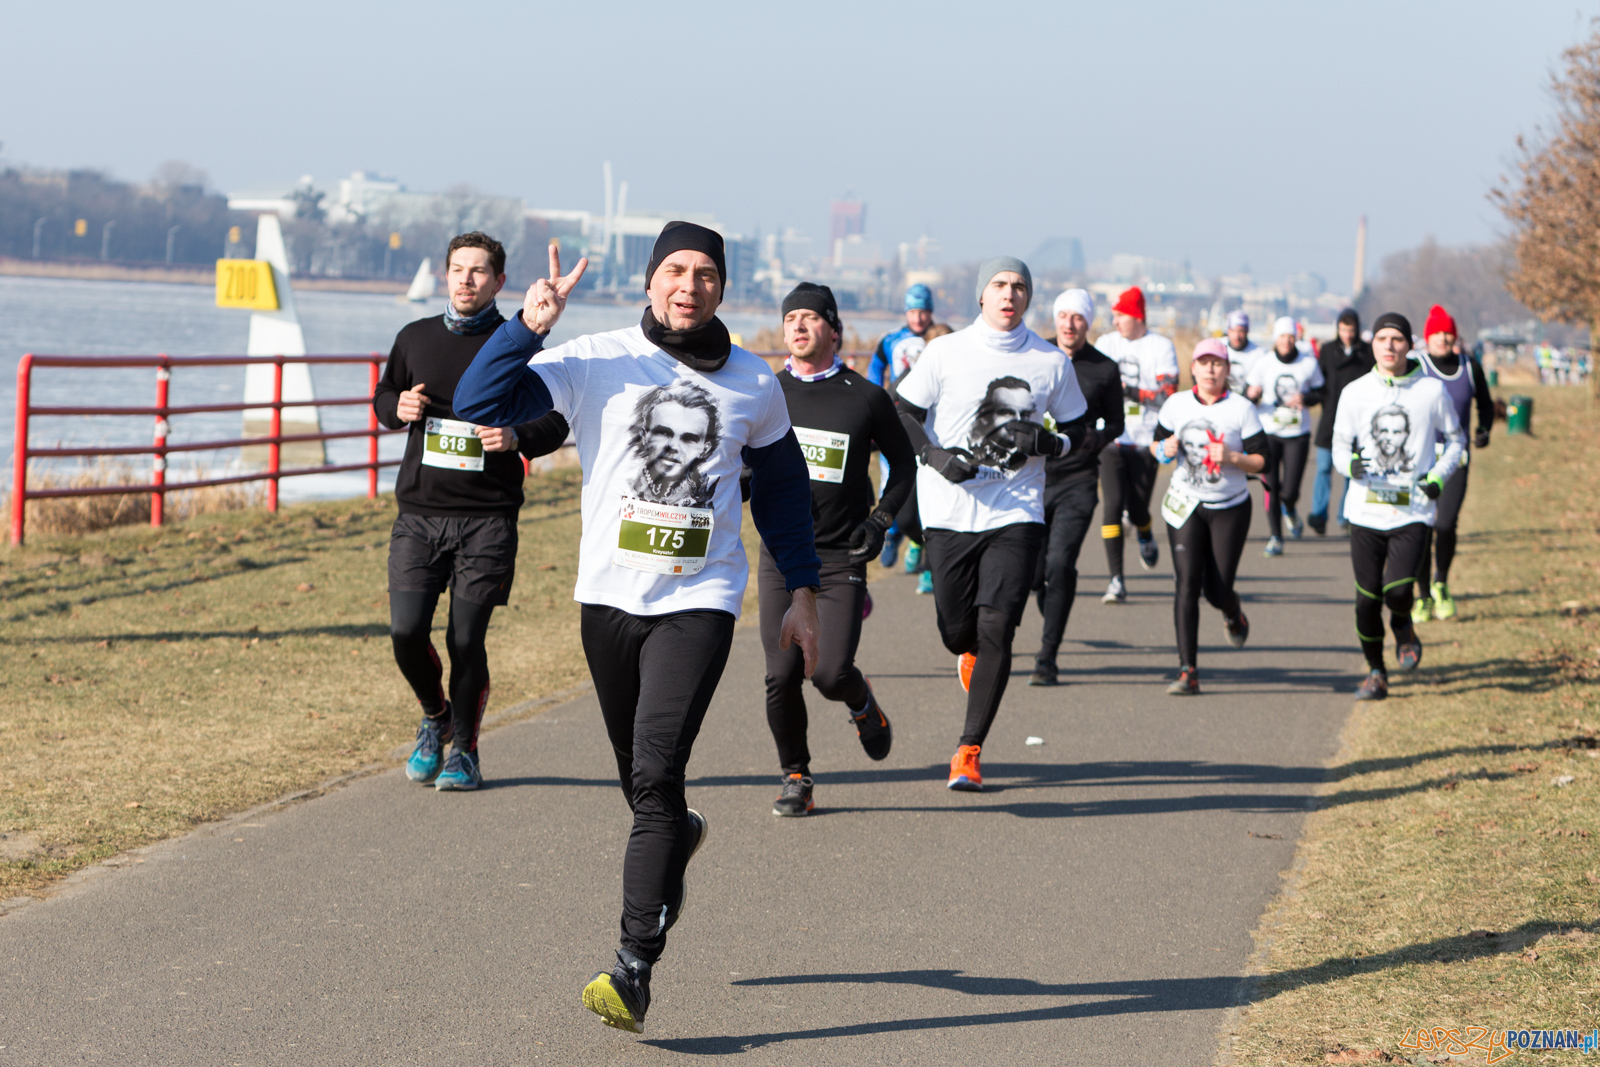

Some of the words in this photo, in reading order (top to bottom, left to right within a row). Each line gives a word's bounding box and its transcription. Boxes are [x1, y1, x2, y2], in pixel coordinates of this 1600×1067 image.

[225, 266, 257, 300] 200
[439, 436, 467, 452] 618
[646, 527, 685, 549] 175
